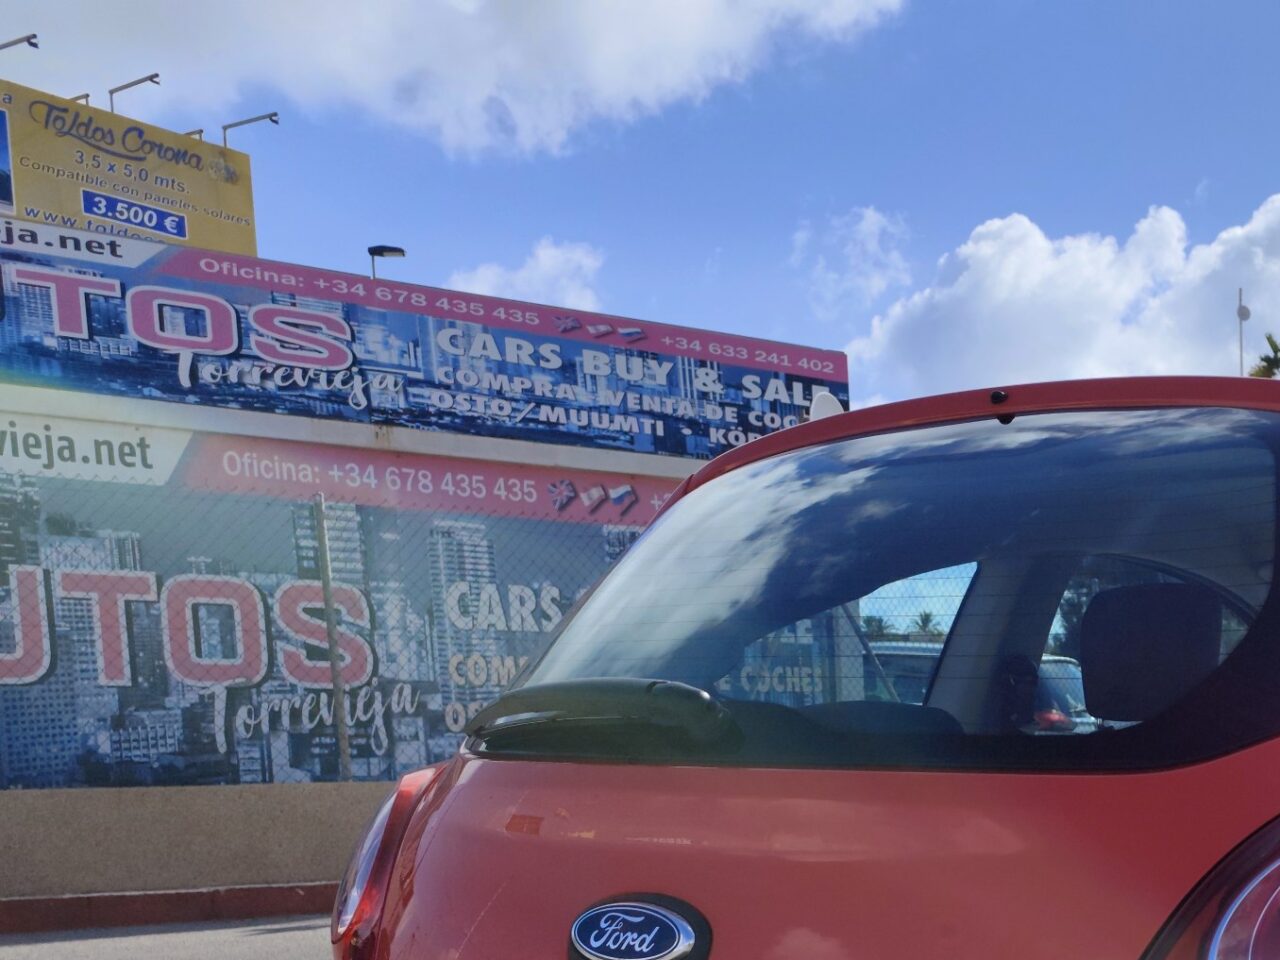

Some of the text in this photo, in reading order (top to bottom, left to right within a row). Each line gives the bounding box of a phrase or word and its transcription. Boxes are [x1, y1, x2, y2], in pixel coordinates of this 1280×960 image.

[29, 100, 204, 173] Toldos Corona
[19, 156, 251, 227] Compatible con paneles solares
[75, 150, 101, 170] 3,5
[123, 164, 149, 184] 5,0
[154, 175, 191, 195] mts.
[0, 220, 123, 259] ja.net
[92, 196, 181, 235] 3.500 €
[199, 257, 540, 325] Oficina: +34 678 435 435
[178, 349, 404, 411] Torrevieja
[436, 327, 563, 370] CARS
[582, 348, 675, 386] BUY
[697, 366, 725, 394] &
[661, 336, 834, 374] +34 633 241 402
[436, 366, 577, 402] COMPRA
[600, 390, 697, 418] VENTA
[705, 403, 738, 423] DE
[222, 450, 538, 504] Oficina: +34 678 435 435
[446, 580, 563, 633] CARS
[199, 677, 421, 756] Torrevieja
[590, 911, 660, 954] Ford
